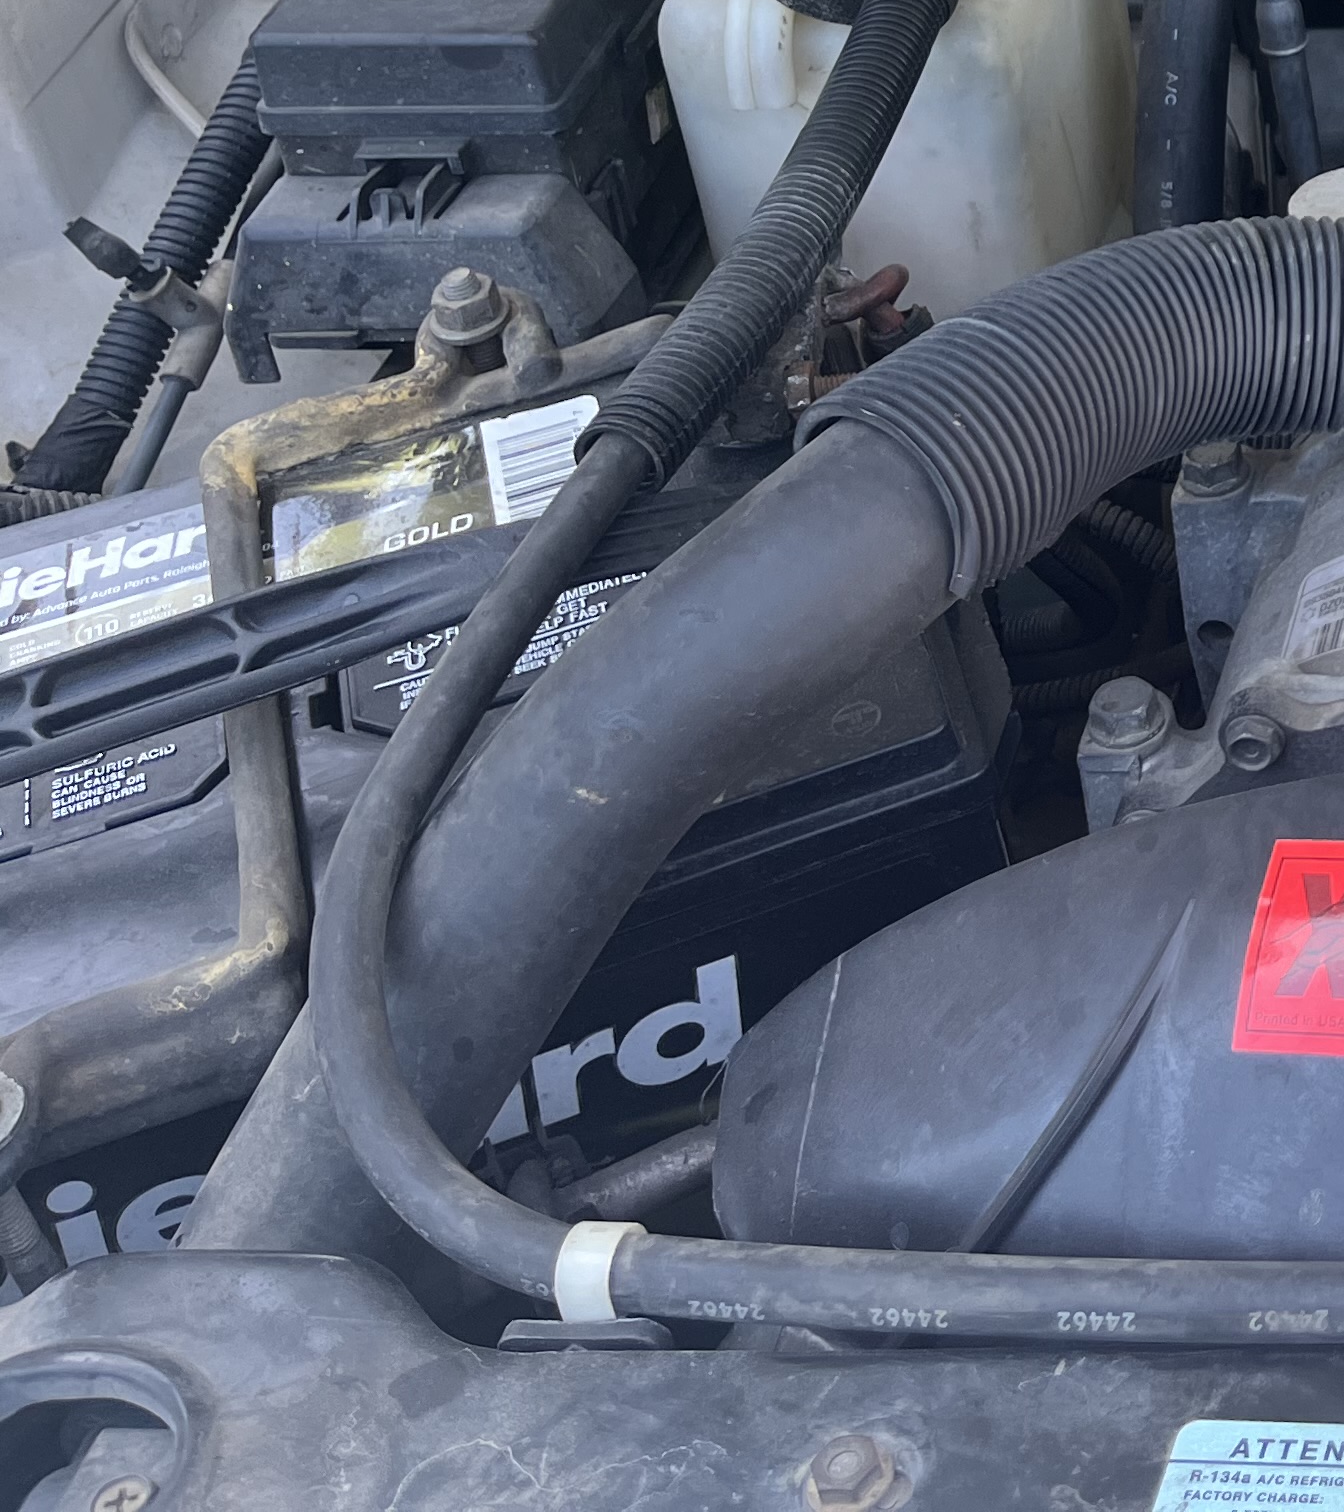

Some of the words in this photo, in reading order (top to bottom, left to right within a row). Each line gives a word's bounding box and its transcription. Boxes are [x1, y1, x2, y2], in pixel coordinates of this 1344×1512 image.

[1164, 71, 1179, 107] A/C
[384, 513, 474, 553] GOLD
[0, 524, 208, 610] ieHar
[11, 612, 31, 626] by:
[32, 593, 88, 619] Advance
[90, 584, 121, 600] Auto
[570, 600, 608, 625] FAST
[83, 619, 120, 641] 110
[51, 755, 135, 789] SULFURIC
[137, 743, 177, 765] ACID
[51, 784, 78, 800] CAN
[84, 769, 127, 789] CAUSE
[51, 780, 122, 809] BLINDNESS
[51, 797, 102, 820] SEVERE
[103, 782, 147, 803] BURNS
[1255, 1011, 1298, 1026] Printed
[688, 1299, 767, 1322] 24462
[869, 1307, 949, 1330] 24462
[1057, 1309, 1137, 1333] 24462
[1248, 1308, 1330, 1332] 24462
[1189, 1469, 1251, 1484] R-134a
[1256, 1474, 1285, 1486] A/C
[1183, 1489, 1252, 1503] FACTORY
[1256, 1492, 1325, 1505] CHARGE:
